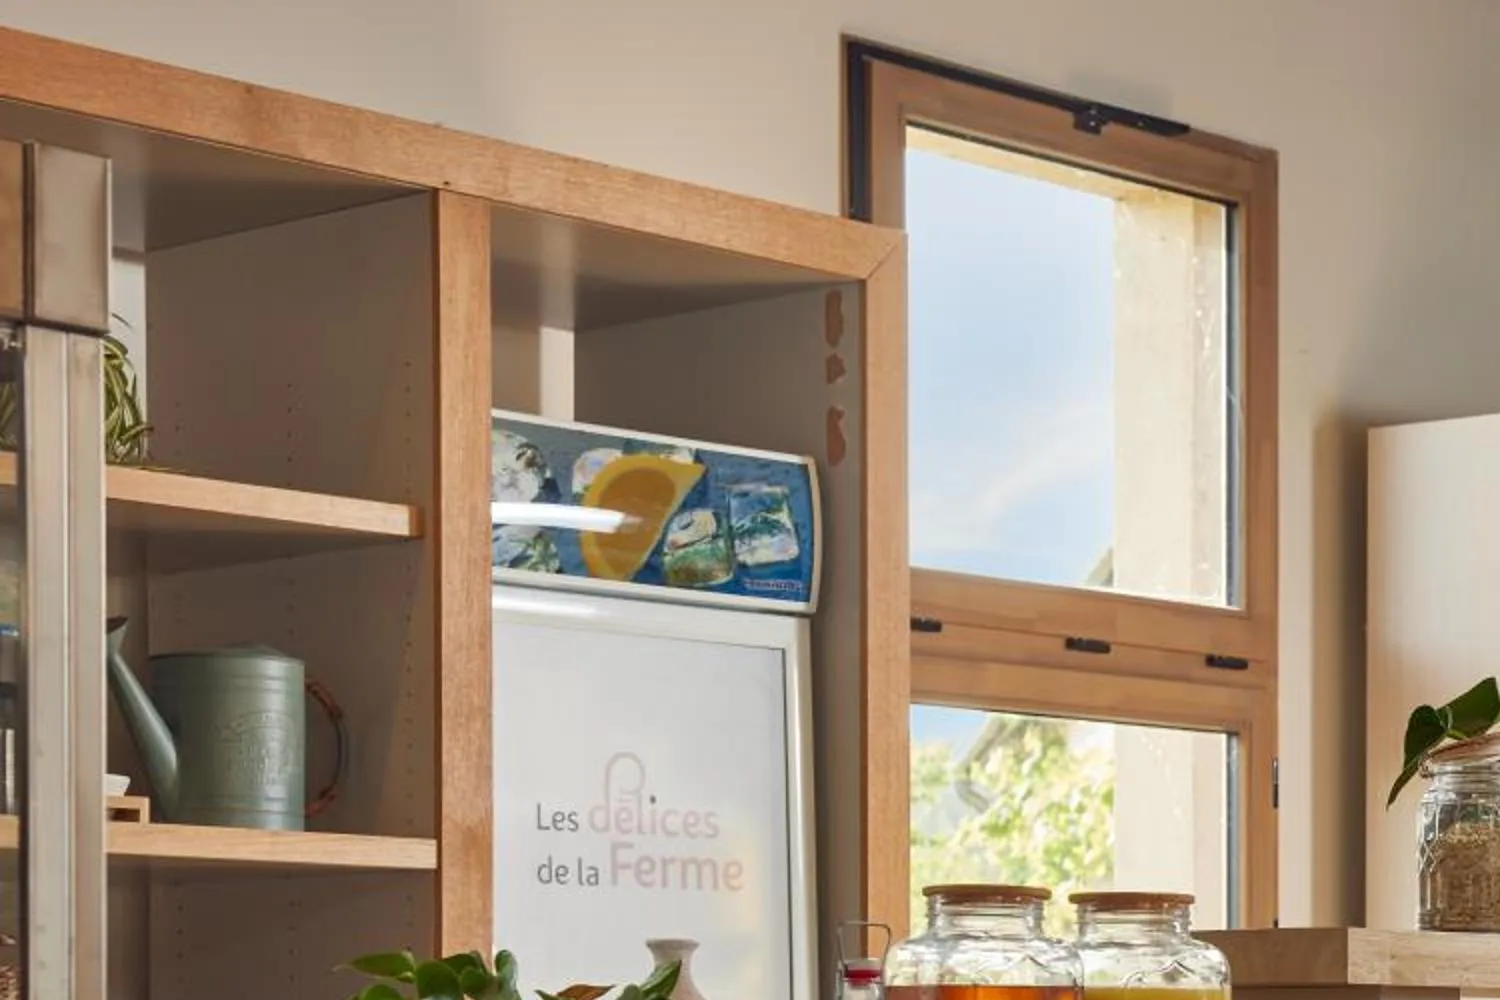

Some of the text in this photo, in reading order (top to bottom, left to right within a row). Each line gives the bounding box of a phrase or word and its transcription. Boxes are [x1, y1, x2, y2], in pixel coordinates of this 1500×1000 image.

[536, 802, 580, 832] Les
[536, 841, 745, 892] de la Ferme
